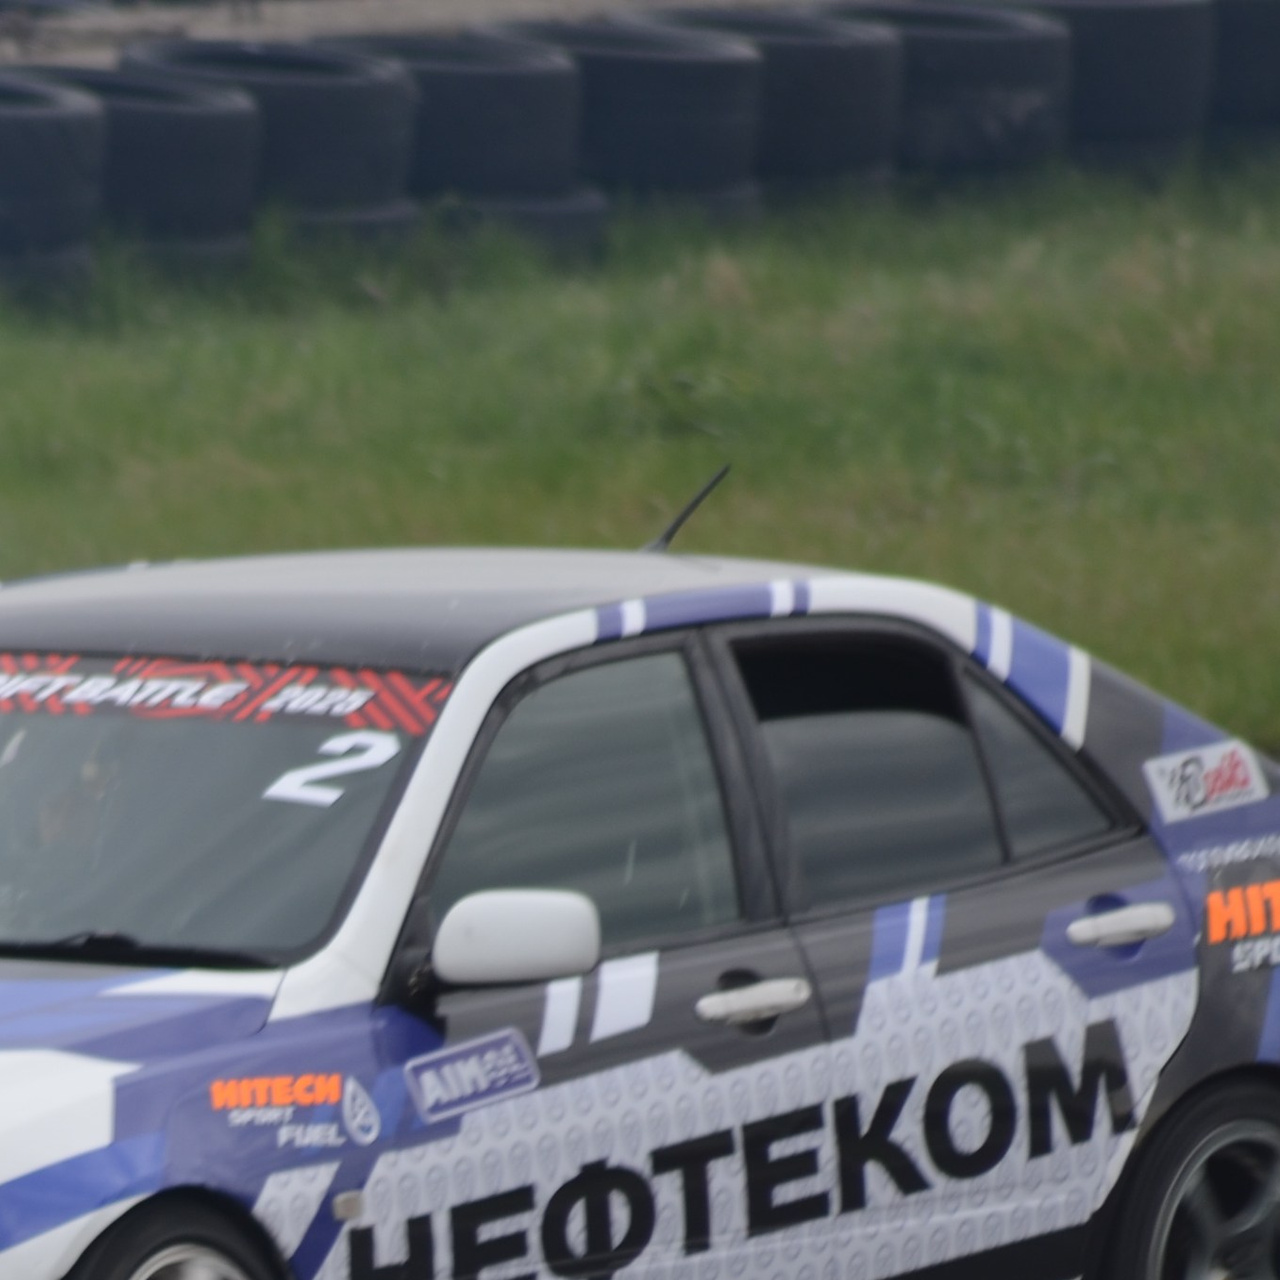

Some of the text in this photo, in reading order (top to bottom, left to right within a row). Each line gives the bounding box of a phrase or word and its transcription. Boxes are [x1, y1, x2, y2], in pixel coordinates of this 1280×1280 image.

[60, 675, 250, 709] BATTLE
[261, 730, 400, 808] 2
[210, 1073, 342, 1111] HITECH
[277, 1123, 347, 1149] FUEL
